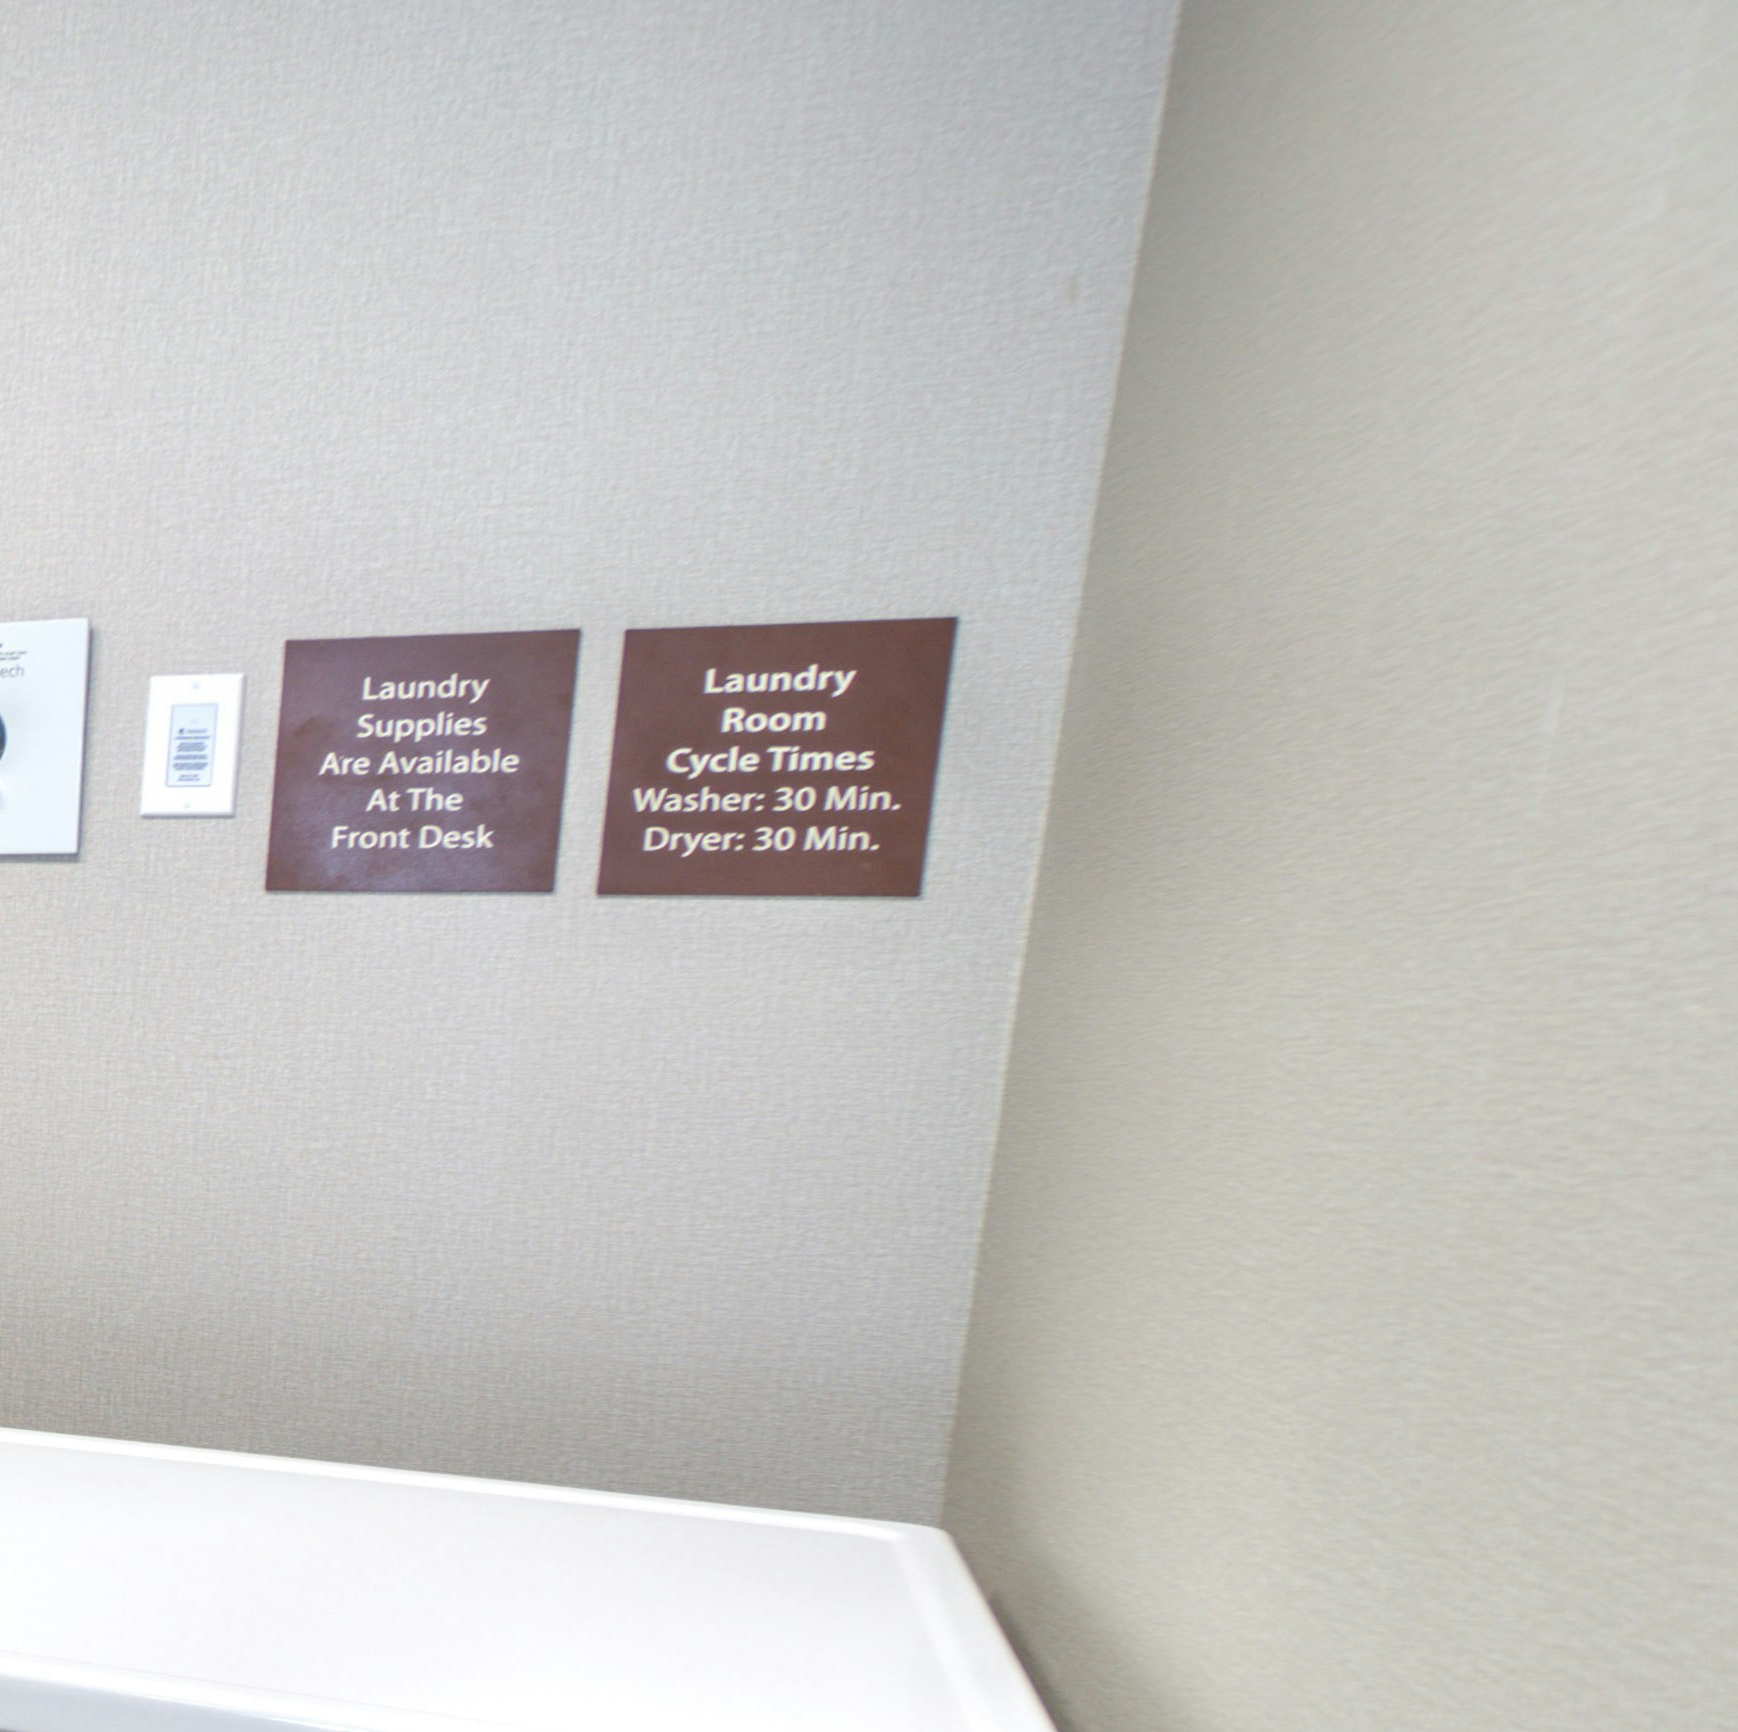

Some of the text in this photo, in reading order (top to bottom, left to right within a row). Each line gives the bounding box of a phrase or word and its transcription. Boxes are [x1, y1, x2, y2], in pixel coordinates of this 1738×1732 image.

[363, 673, 490, 704] Laundry
[703, 664, 857, 698] Laundry
[356, 712, 487, 742] Supplies
[721, 707, 826, 732] Room
[319, 748, 520, 776] Are Available
[666, 746, 875, 780] Cycle Times
[366, 787, 463, 812] At The
[633, 786, 902, 812] Washer: 30 Min.
[331, 824, 494, 848] Front Desk
[643, 826, 880, 858] Dryer: 30 Min.
